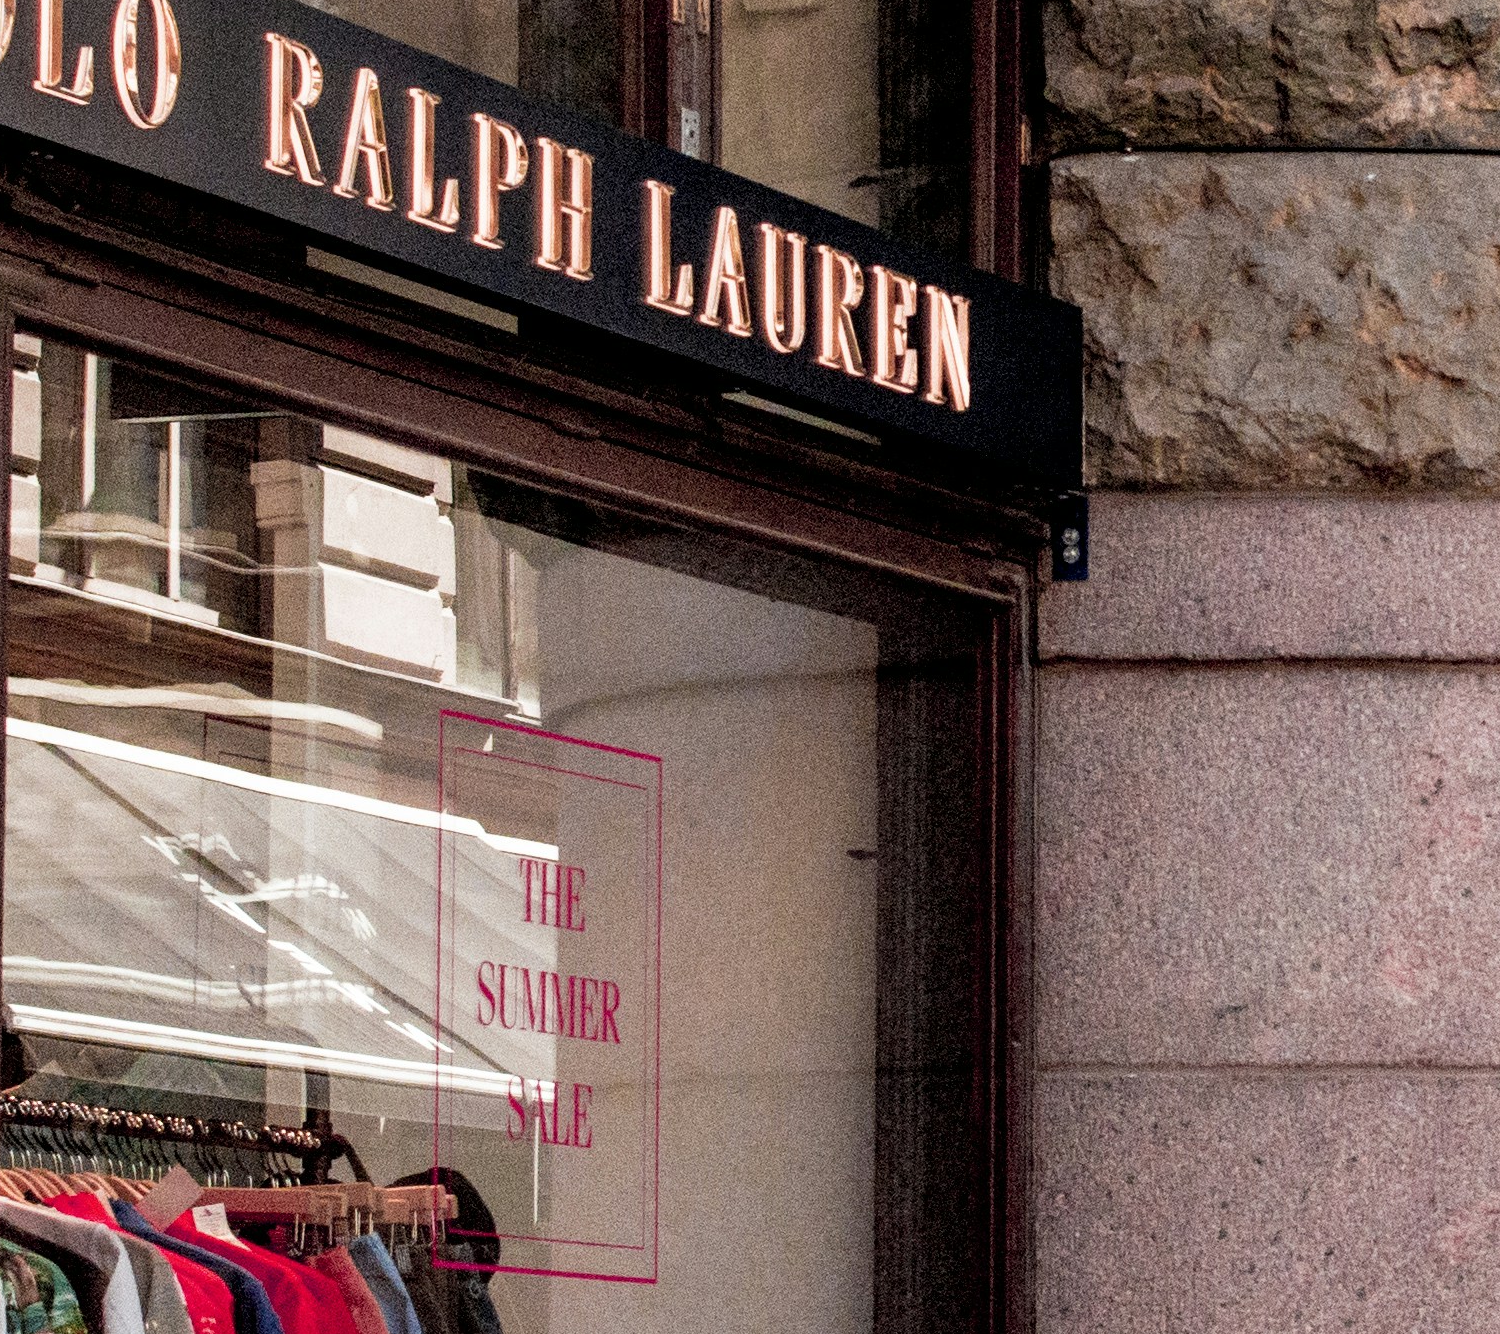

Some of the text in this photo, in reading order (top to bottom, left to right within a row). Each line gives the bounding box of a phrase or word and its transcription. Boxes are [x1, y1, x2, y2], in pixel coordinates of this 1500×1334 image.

[263, 30, 596, 281] RALPH
[643, 178, 972, 413] LAUREN
[519, 857, 587, 933] THE
[476, 960, 622, 1045] SUMMER
[505, 1075, 593, 1151] SALE
